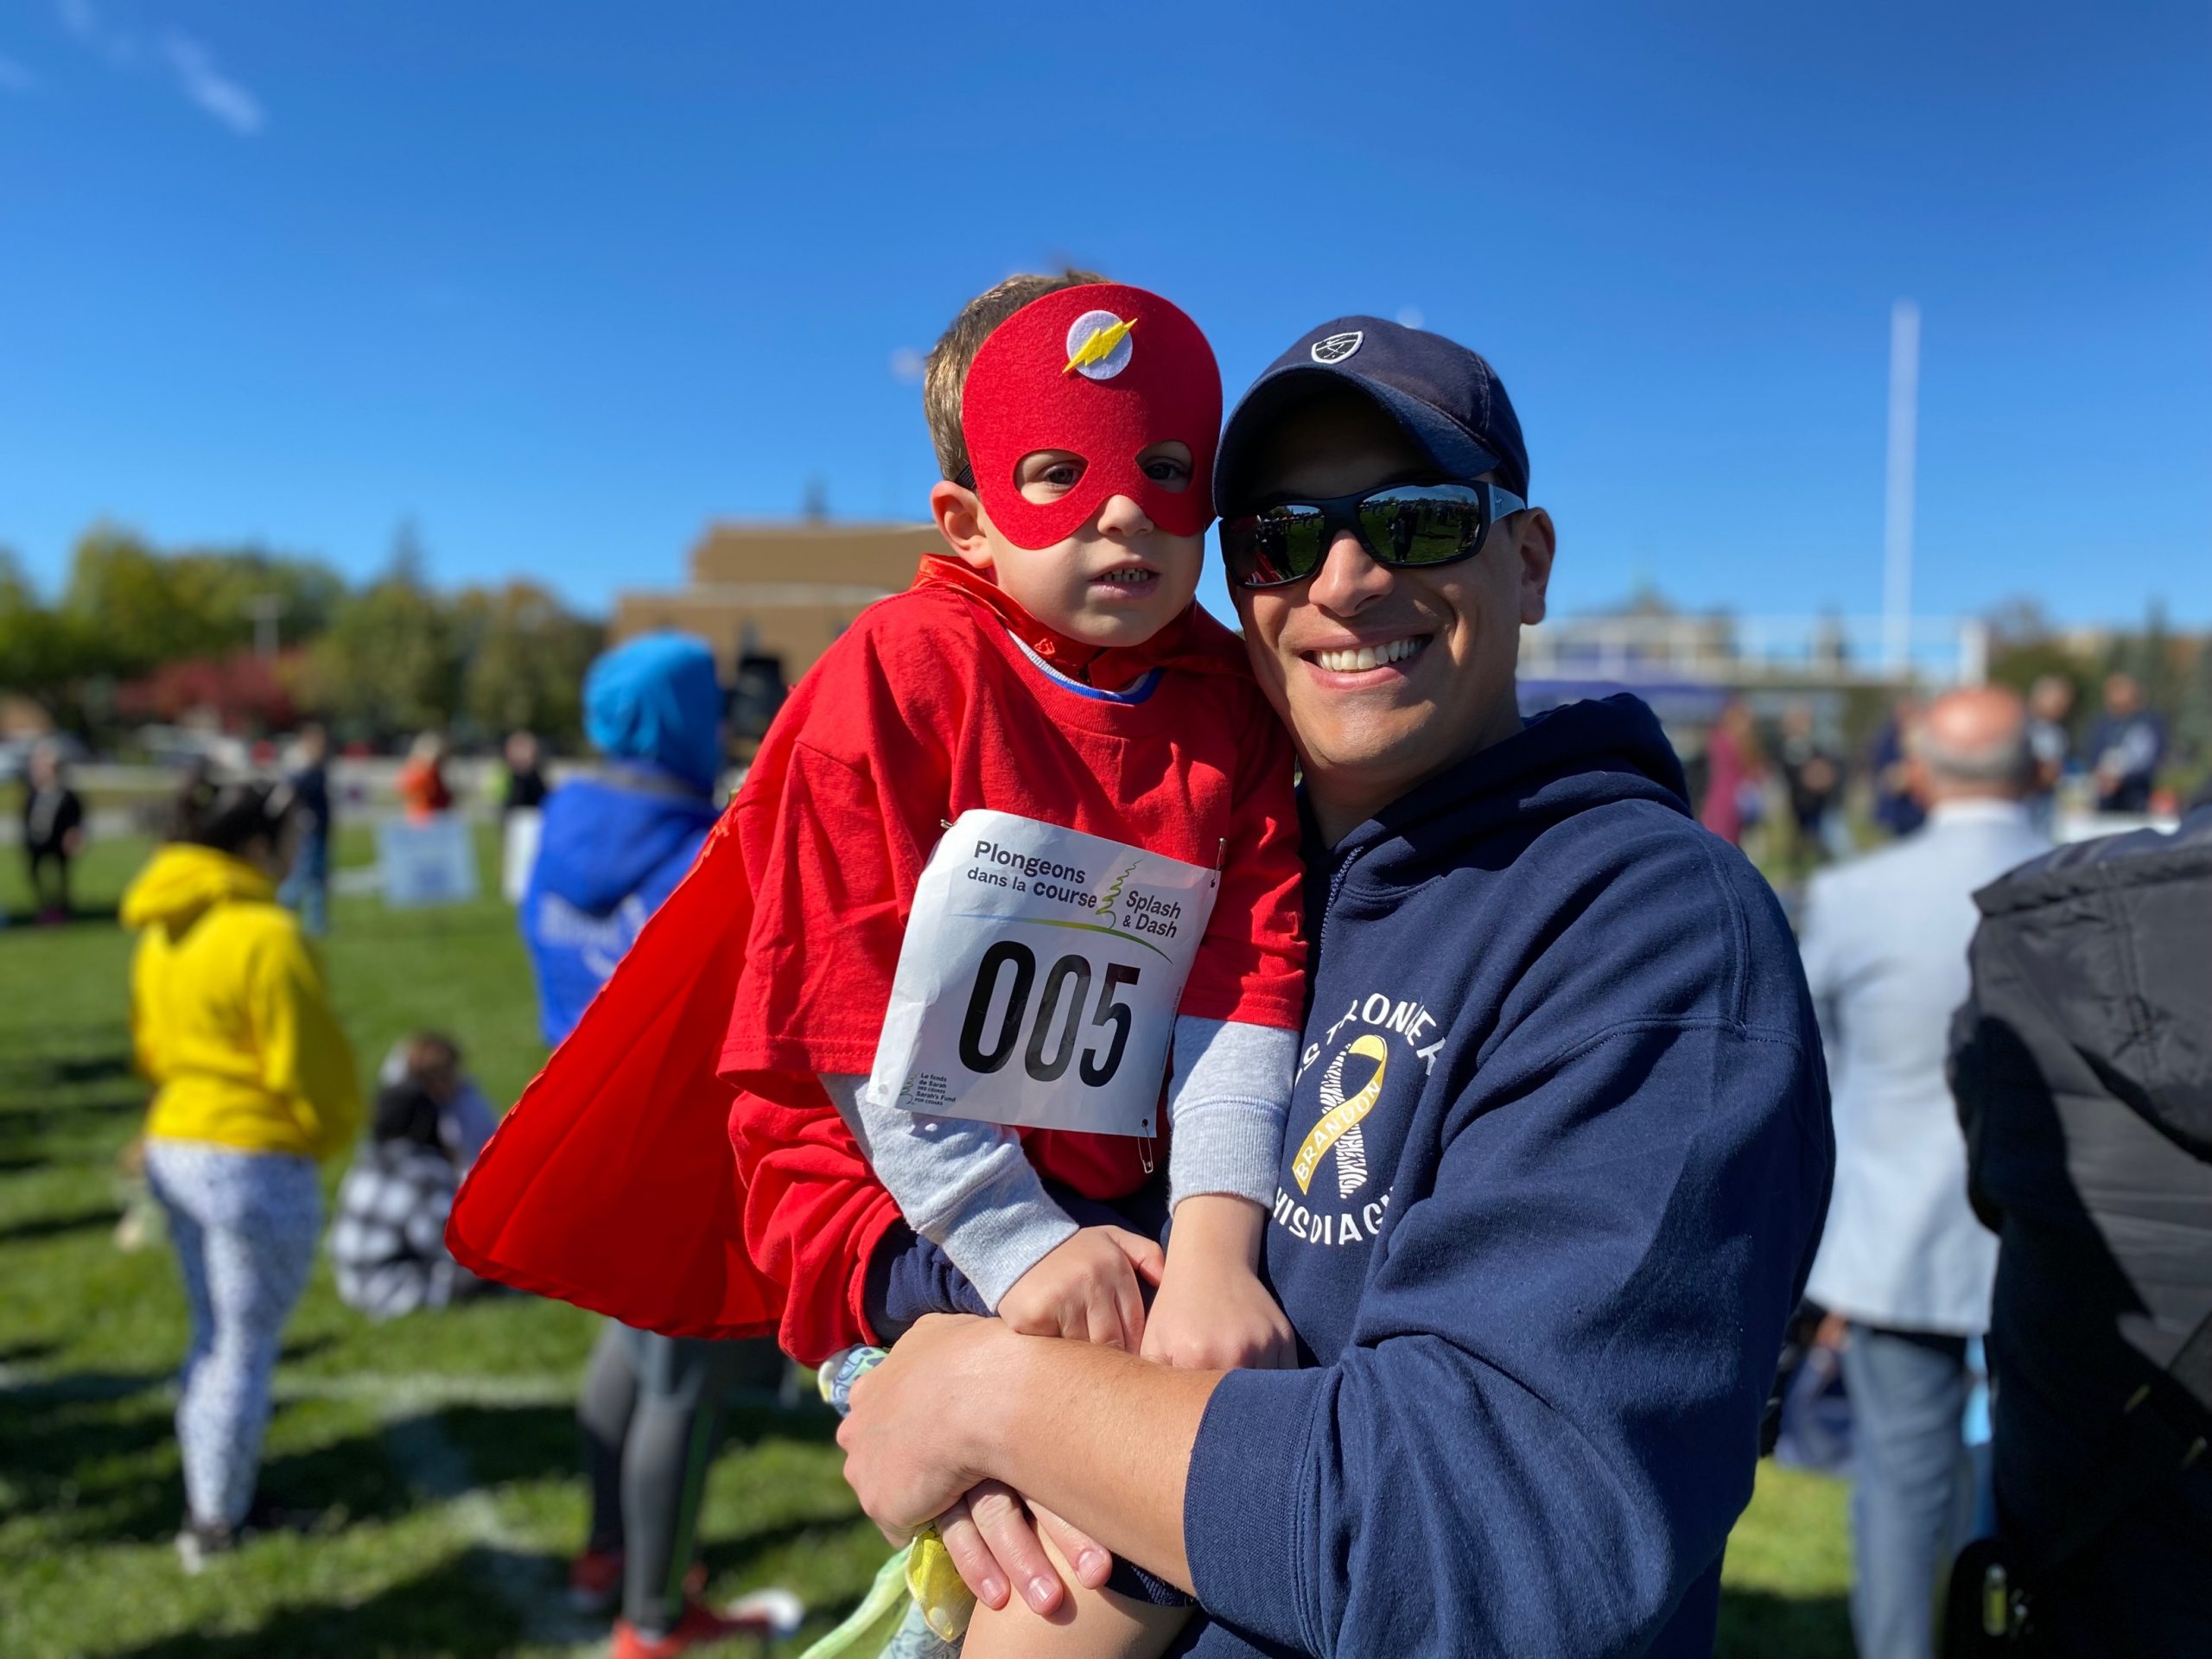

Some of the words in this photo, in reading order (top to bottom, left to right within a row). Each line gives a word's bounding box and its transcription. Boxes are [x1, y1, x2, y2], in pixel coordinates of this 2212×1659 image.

[974, 841, 1085, 884] Plongeons
[967, 868, 1007, 887] dans
[1012, 876, 1026, 892] la
[1033, 881, 1097, 908] course
[1126, 890, 1182, 919] Splash
[1122, 914, 1131, 927] &
[1135, 913, 1177, 938] Dash
[958, 940, 1141, 1088] 005
[1295, 1080, 1381, 1182] BRANDON
